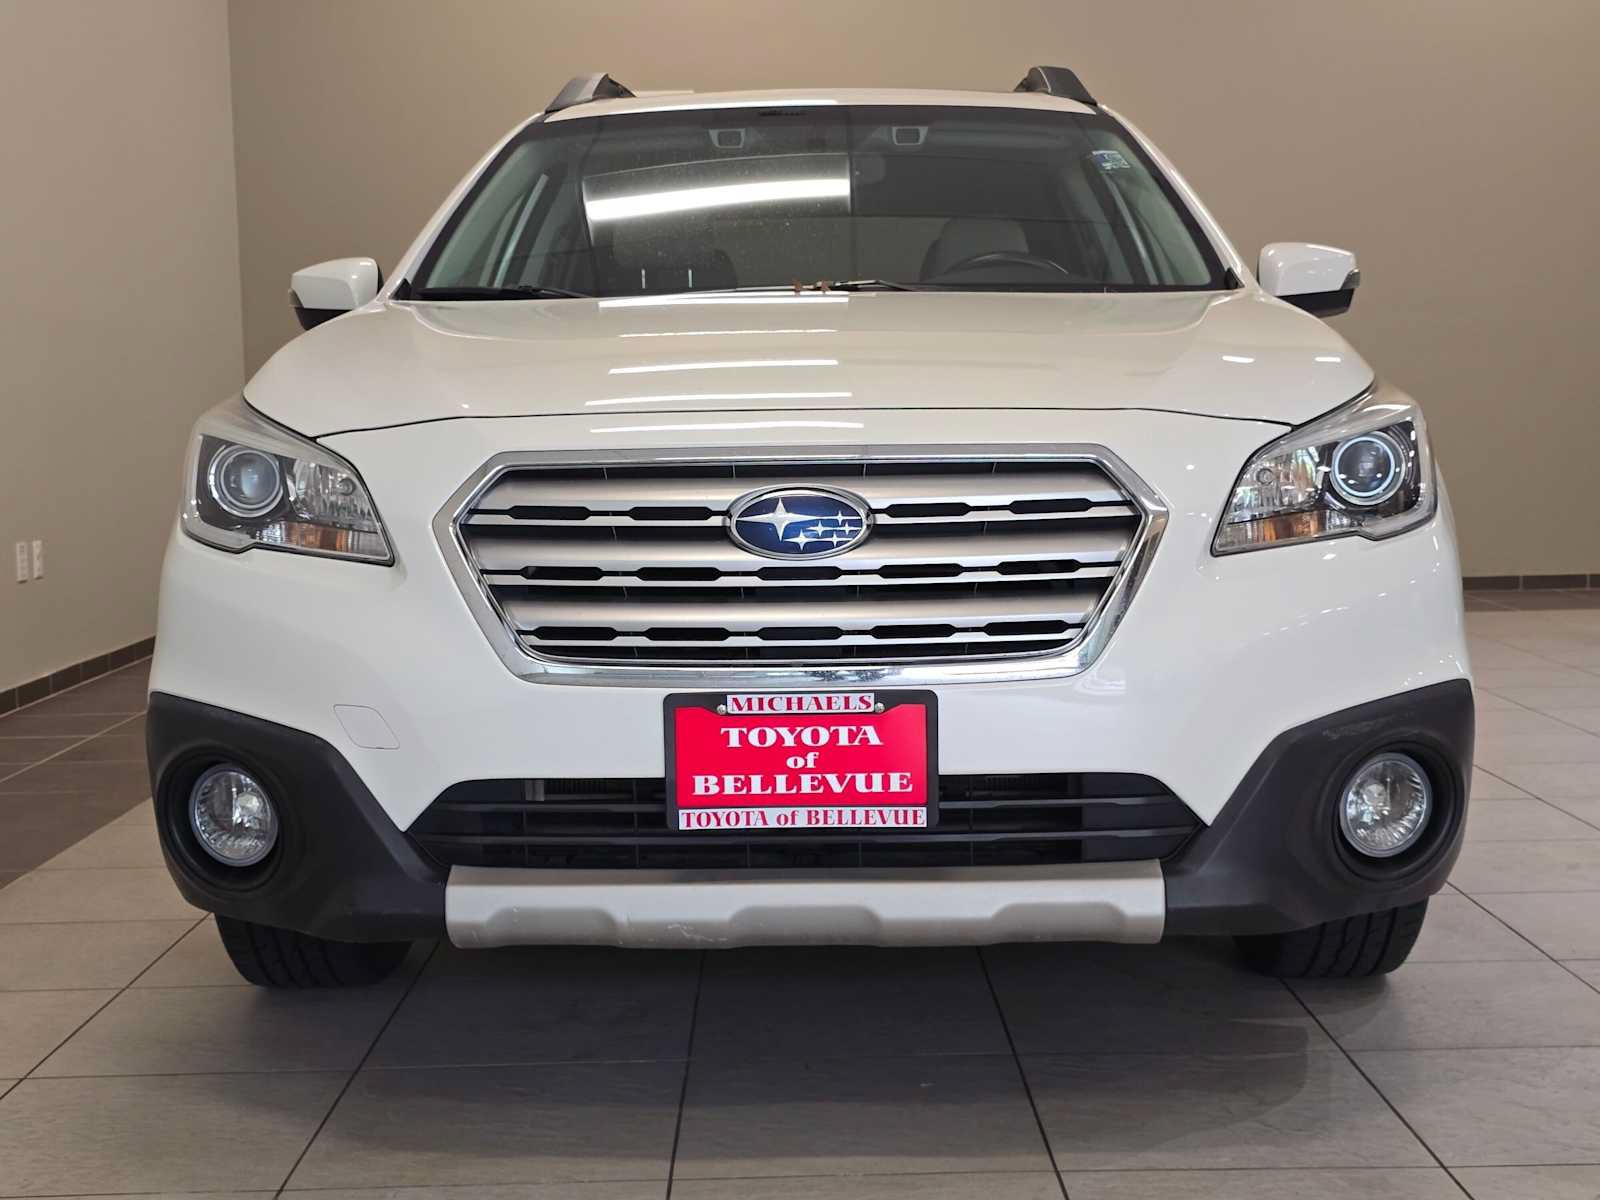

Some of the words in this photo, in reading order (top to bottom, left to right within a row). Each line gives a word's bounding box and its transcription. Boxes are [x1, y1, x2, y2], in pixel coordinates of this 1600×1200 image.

[731, 695, 873, 712] MICHAELS
[720, 725, 883, 748] TOYOTA
[786, 752, 819, 769] of
[692, 772, 913, 795] BELLEVUE
[681, 810, 769, 828] TOYOTA
[776, 810, 800, 826] of
[807, 808, 925, 826] BELLEVUE
